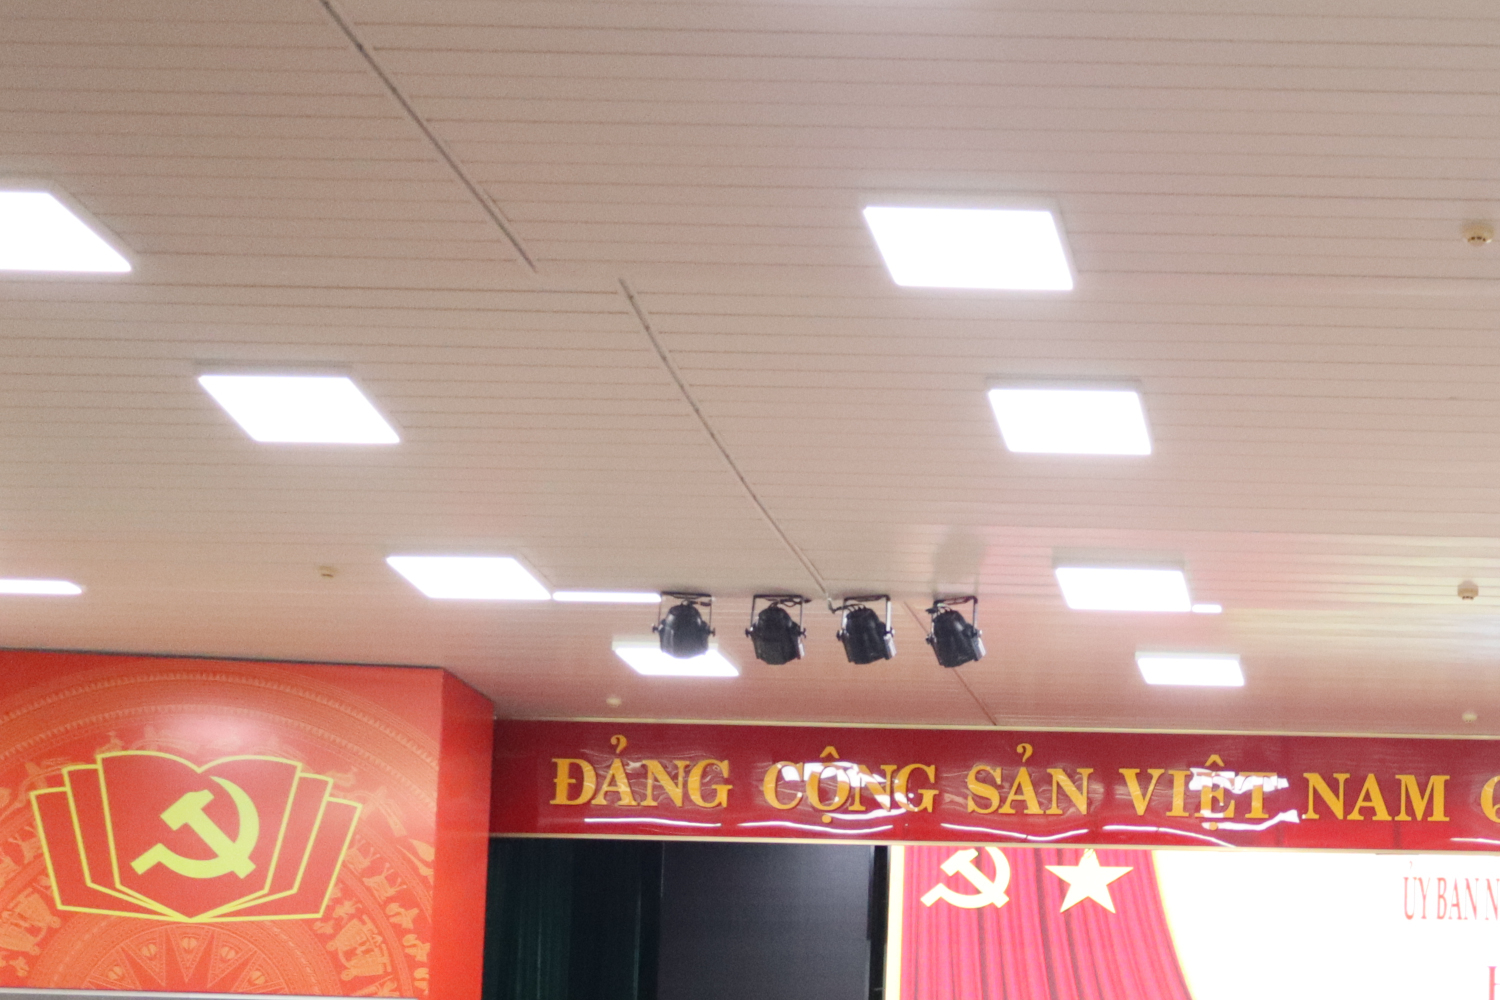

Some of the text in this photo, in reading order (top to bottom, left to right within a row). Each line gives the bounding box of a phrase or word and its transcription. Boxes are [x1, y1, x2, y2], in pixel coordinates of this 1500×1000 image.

[549, 735, 733, 808] ĐẢNG
[763, 746, 940, 823] CỘNG
[967, 743, 1093, 816] SẢN
[1119, 754, 1278, 831] VIỆT
[1303, 772, 1450, 822] NAM
[1403, 861, 1431, 920] ỦY
[1437, 877, 1479, 920] BAN
